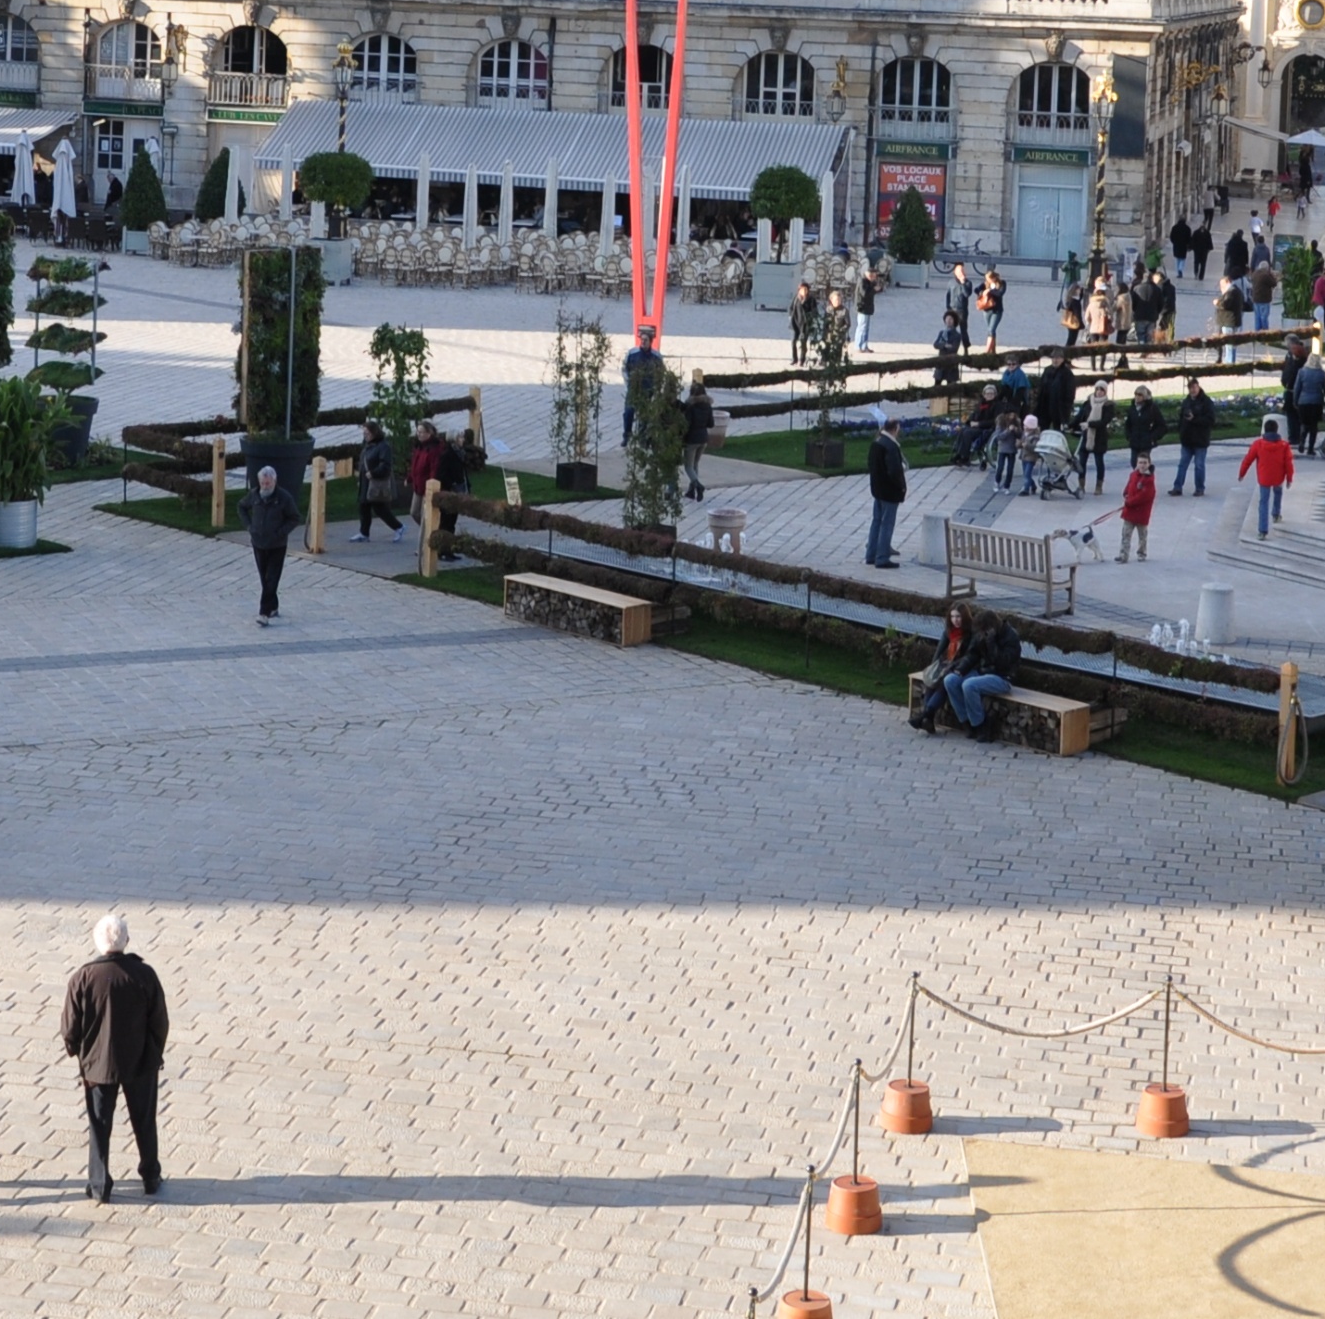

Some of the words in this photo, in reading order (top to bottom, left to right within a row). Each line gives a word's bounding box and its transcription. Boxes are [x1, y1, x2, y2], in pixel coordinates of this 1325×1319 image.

[883, 165, 902, 173] VOS
[904, 166, 941, 175] LOCAUX
[897, 175, 927, 183] PLACE
[887, 183, 936, 193] STANSLAS
